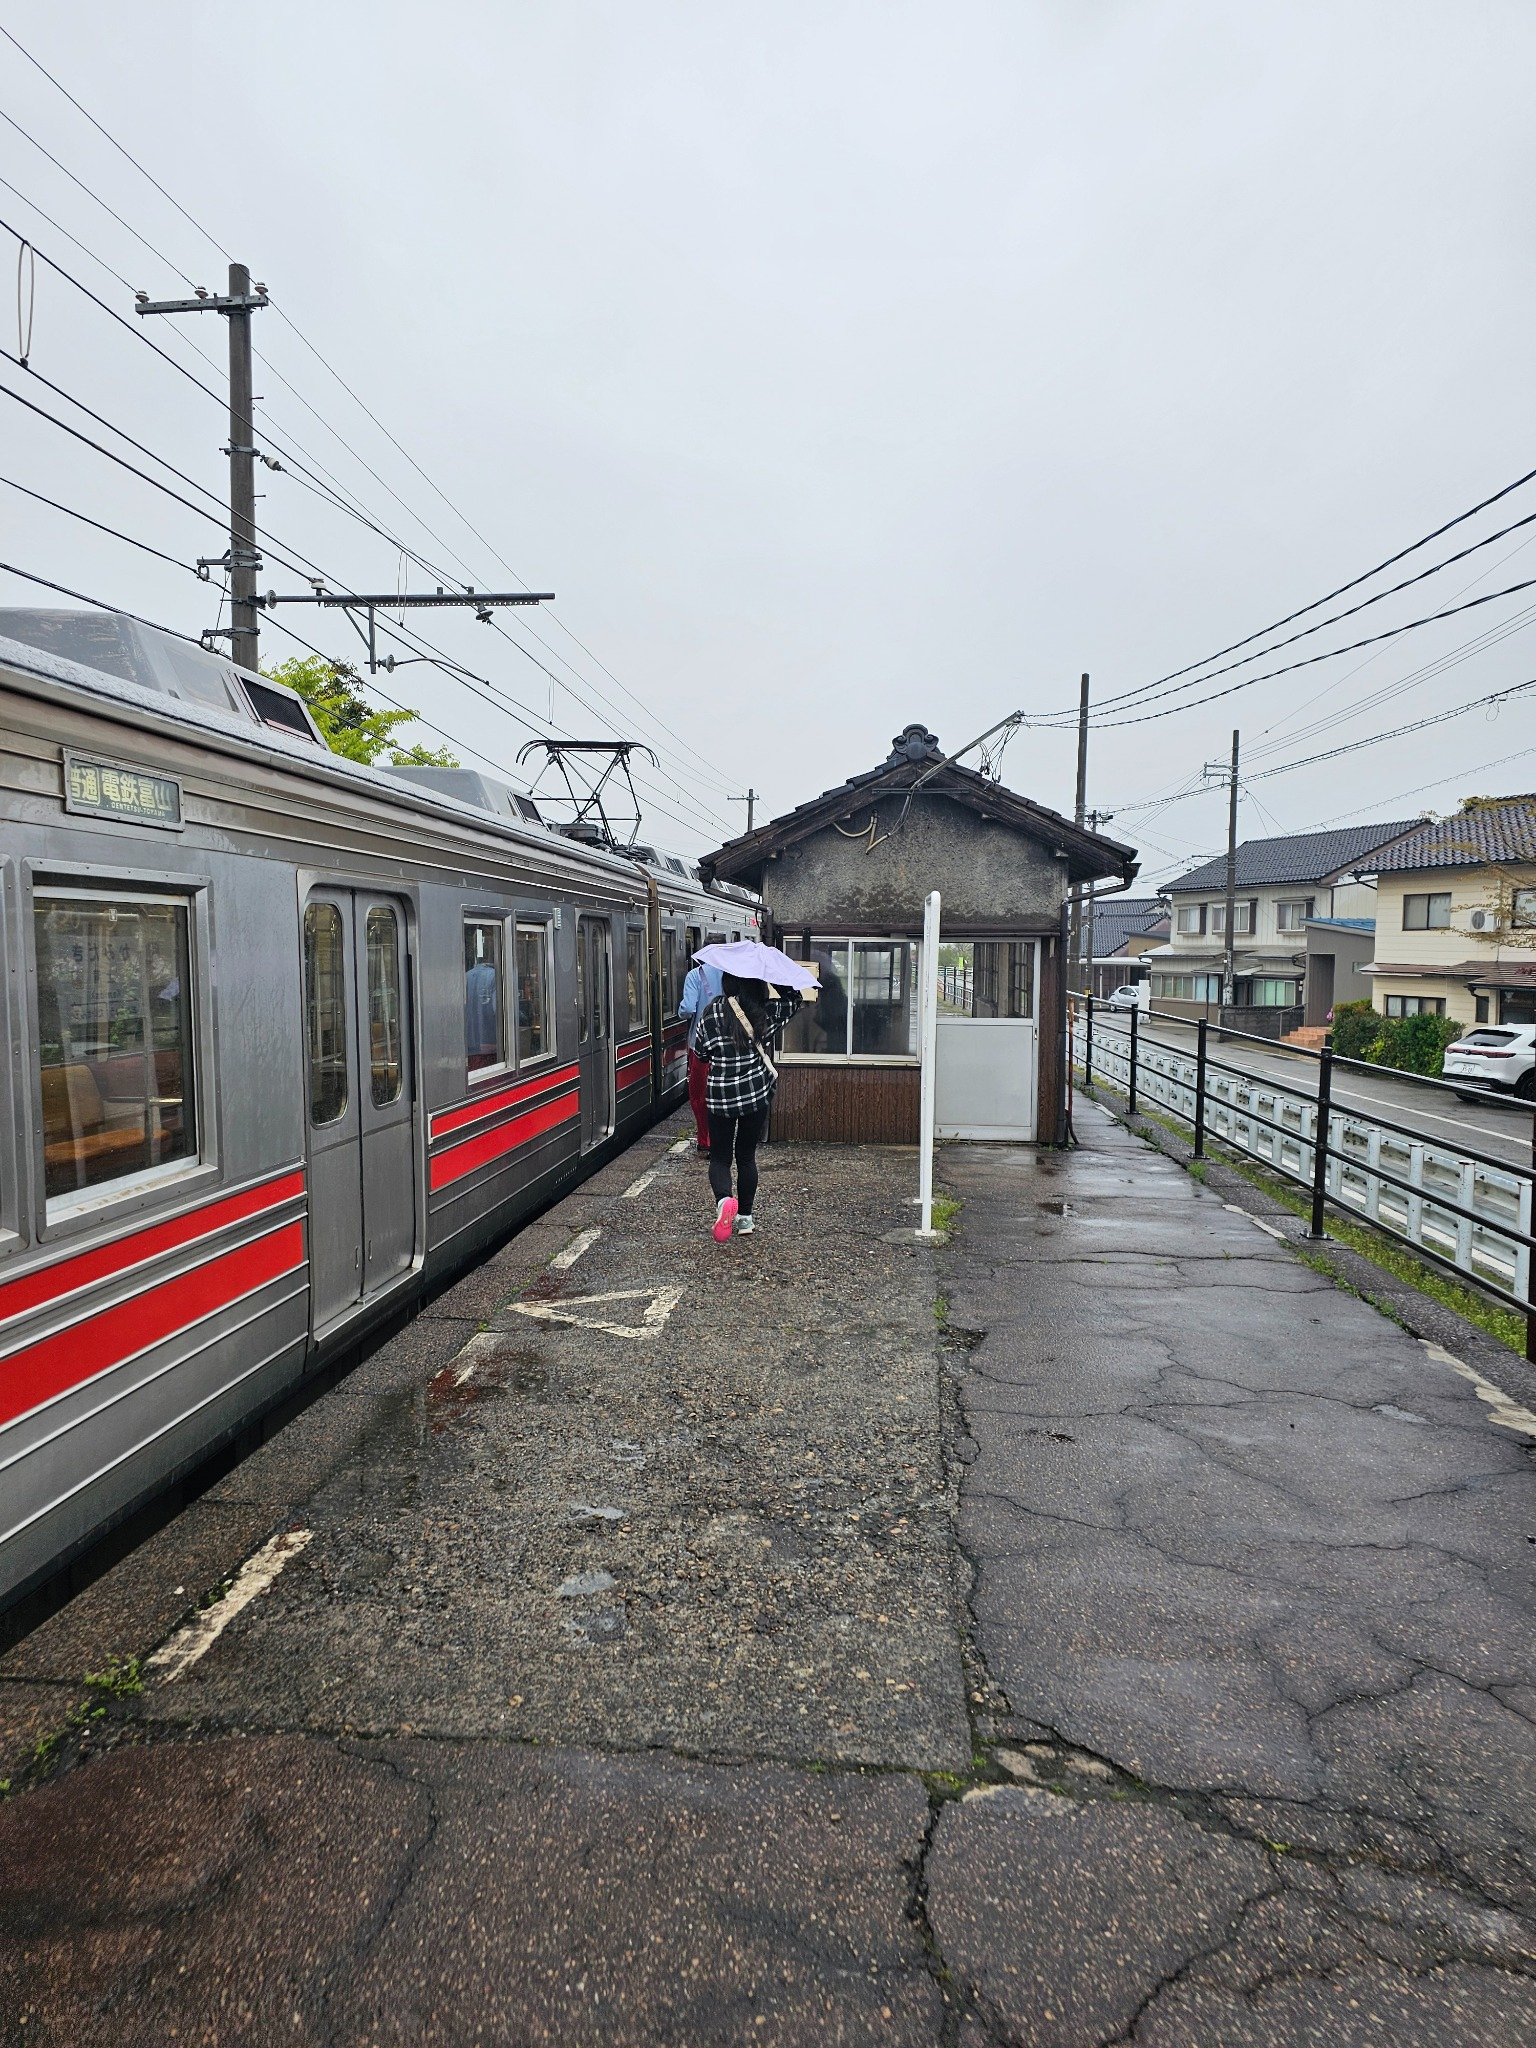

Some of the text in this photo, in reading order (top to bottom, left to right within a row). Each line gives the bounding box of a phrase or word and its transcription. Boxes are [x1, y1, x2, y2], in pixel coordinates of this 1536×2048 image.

[101, 769, 173, 811] 電鉄富山
[111, 802, 166, 818] DENTETSU-TOYAMA
